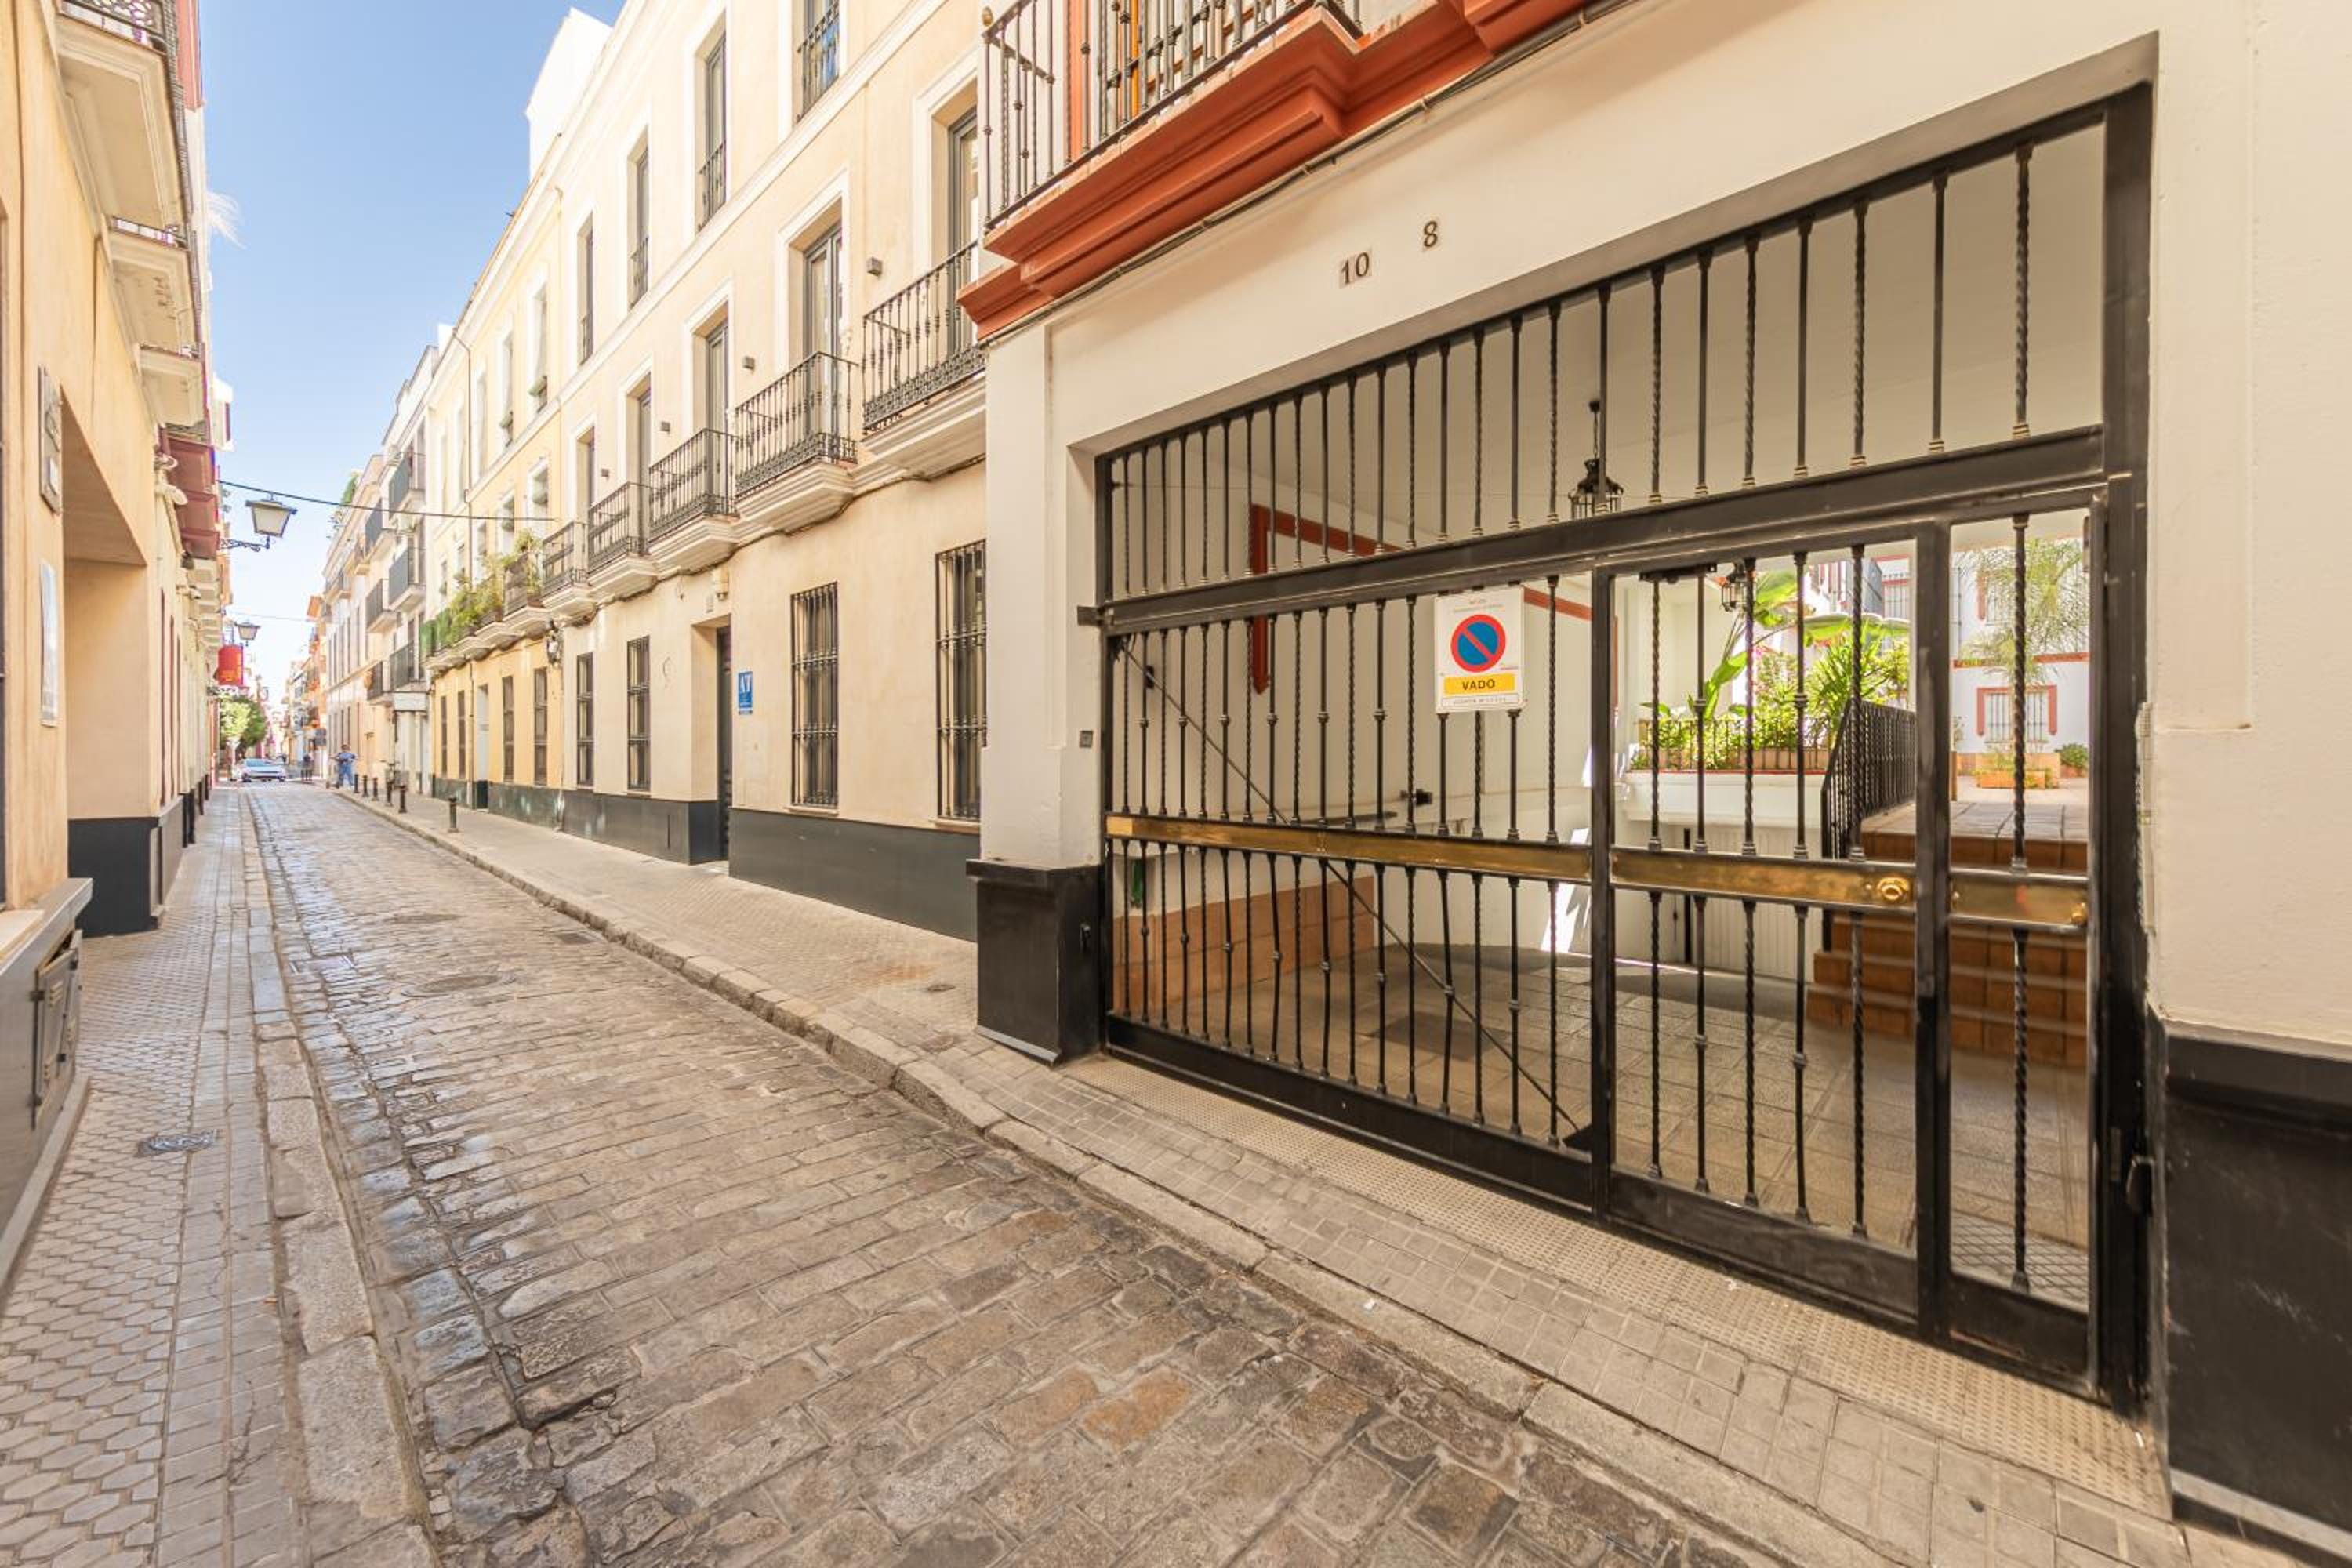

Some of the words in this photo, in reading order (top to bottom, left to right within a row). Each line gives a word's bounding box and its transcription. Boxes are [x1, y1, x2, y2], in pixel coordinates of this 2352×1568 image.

[1423, 220, 1439, 248] 8
[1341, 252, 1370, 285] 10
[1462, 678, 1496, 691] VADO
